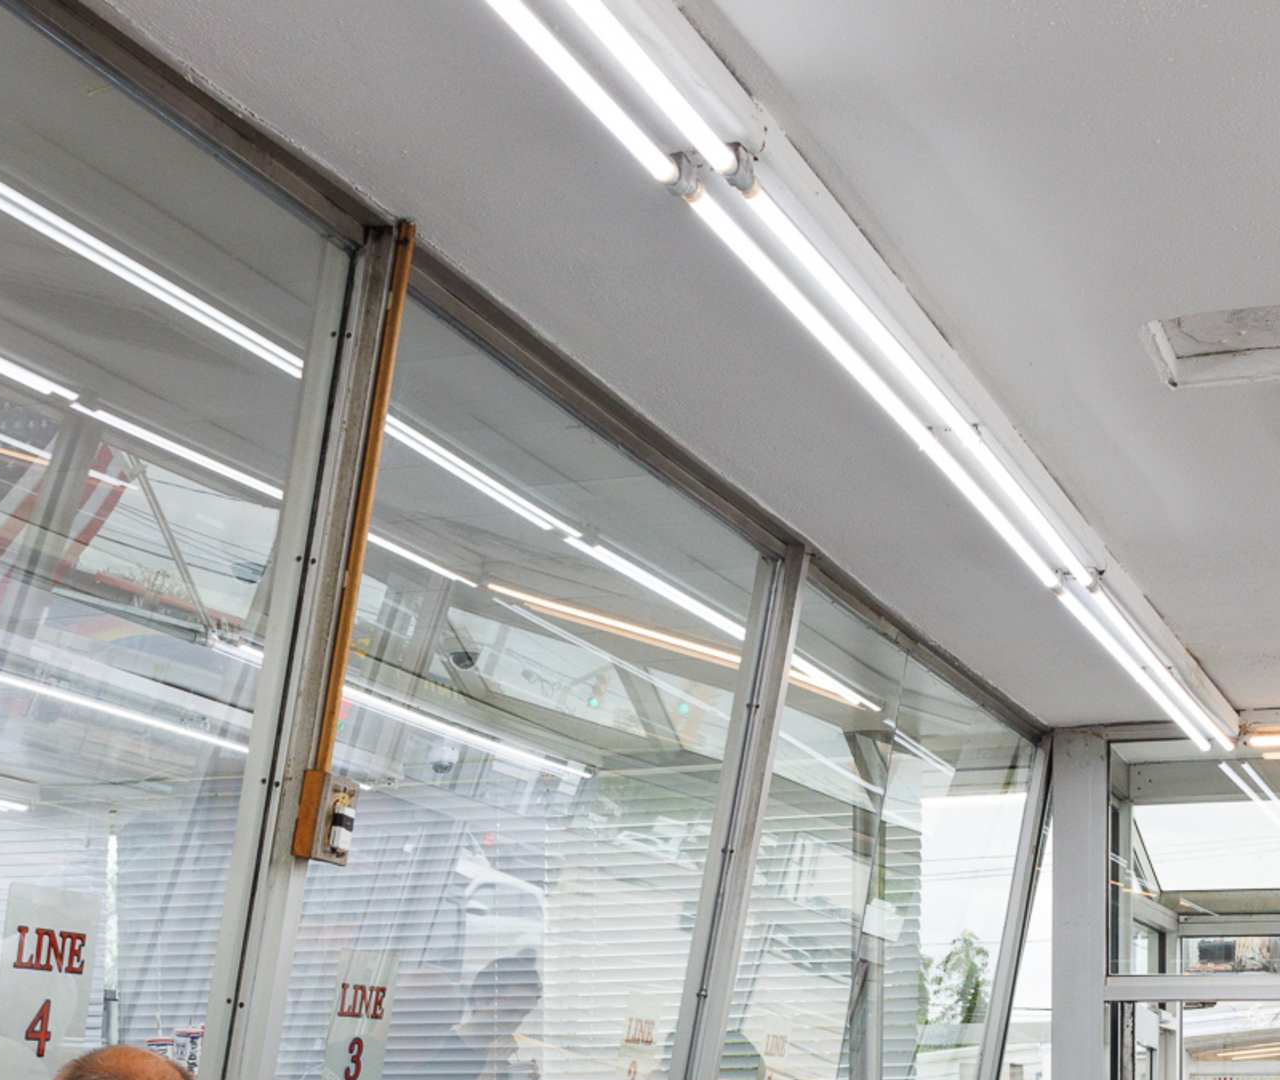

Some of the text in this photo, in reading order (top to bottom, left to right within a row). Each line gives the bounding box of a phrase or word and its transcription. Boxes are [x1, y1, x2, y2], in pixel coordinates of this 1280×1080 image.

[13, 925, 86, 974] LINE
[337, 982, 386, 1020] LINE
[24, 999, 53, 1058] 4
